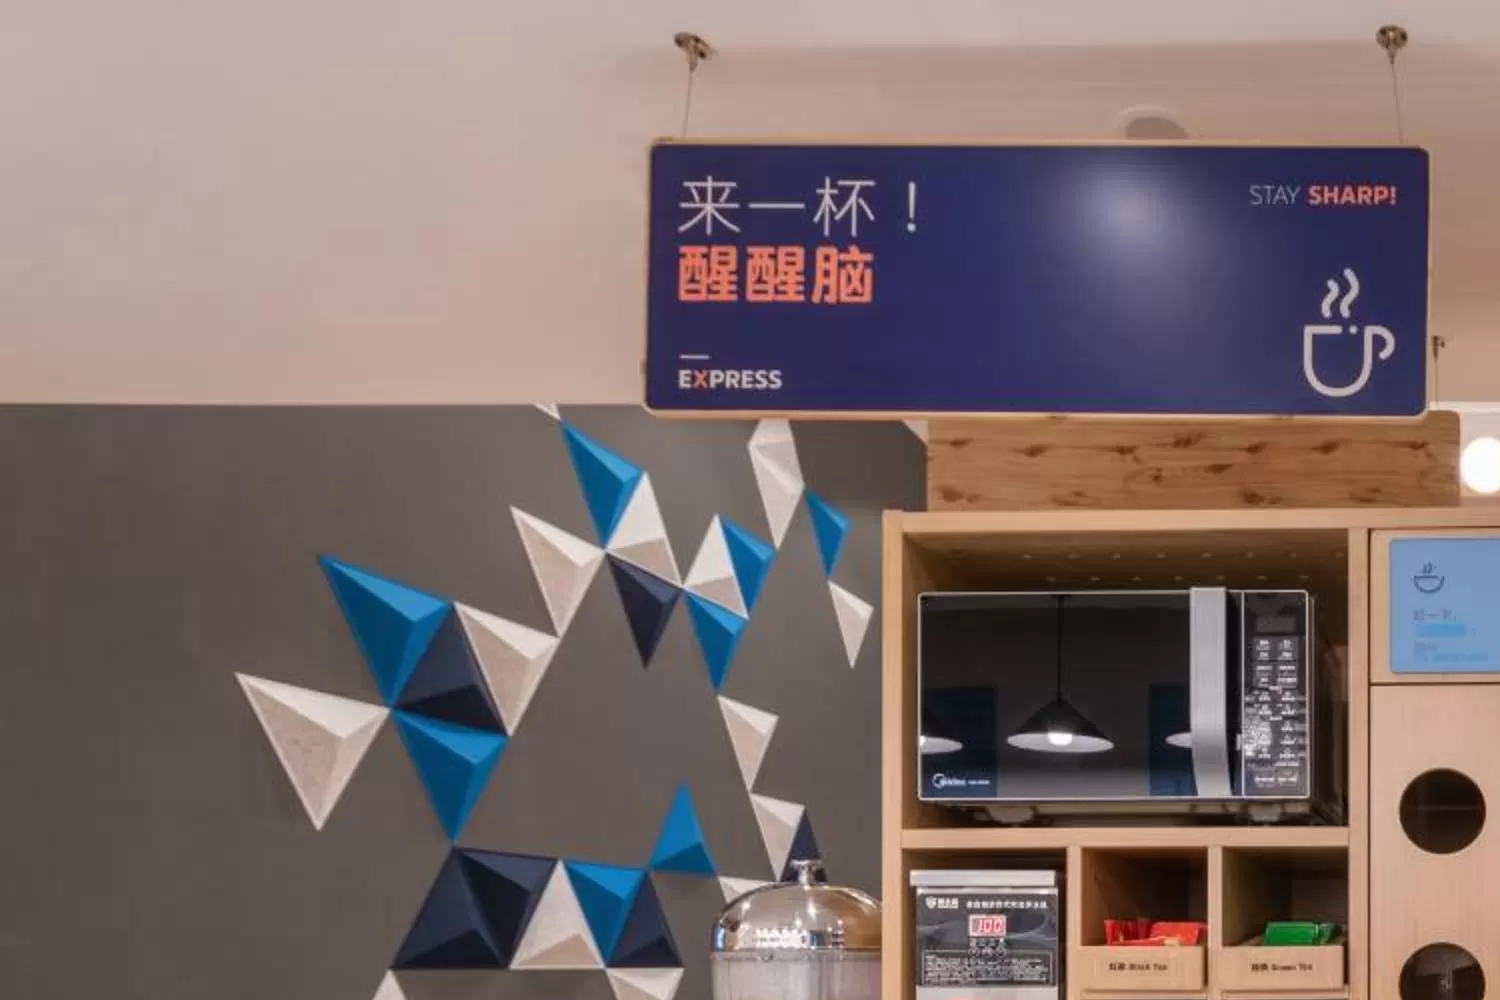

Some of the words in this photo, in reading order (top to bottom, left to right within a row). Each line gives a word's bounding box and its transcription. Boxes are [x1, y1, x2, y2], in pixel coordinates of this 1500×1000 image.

[1249, 185, 1300, 206] STAY
[1308, 185, 1397, 206] SHARP!
[677, 245, 874, 304] 醒醒脑
[678, 369, 783, 390] EXPRESS
